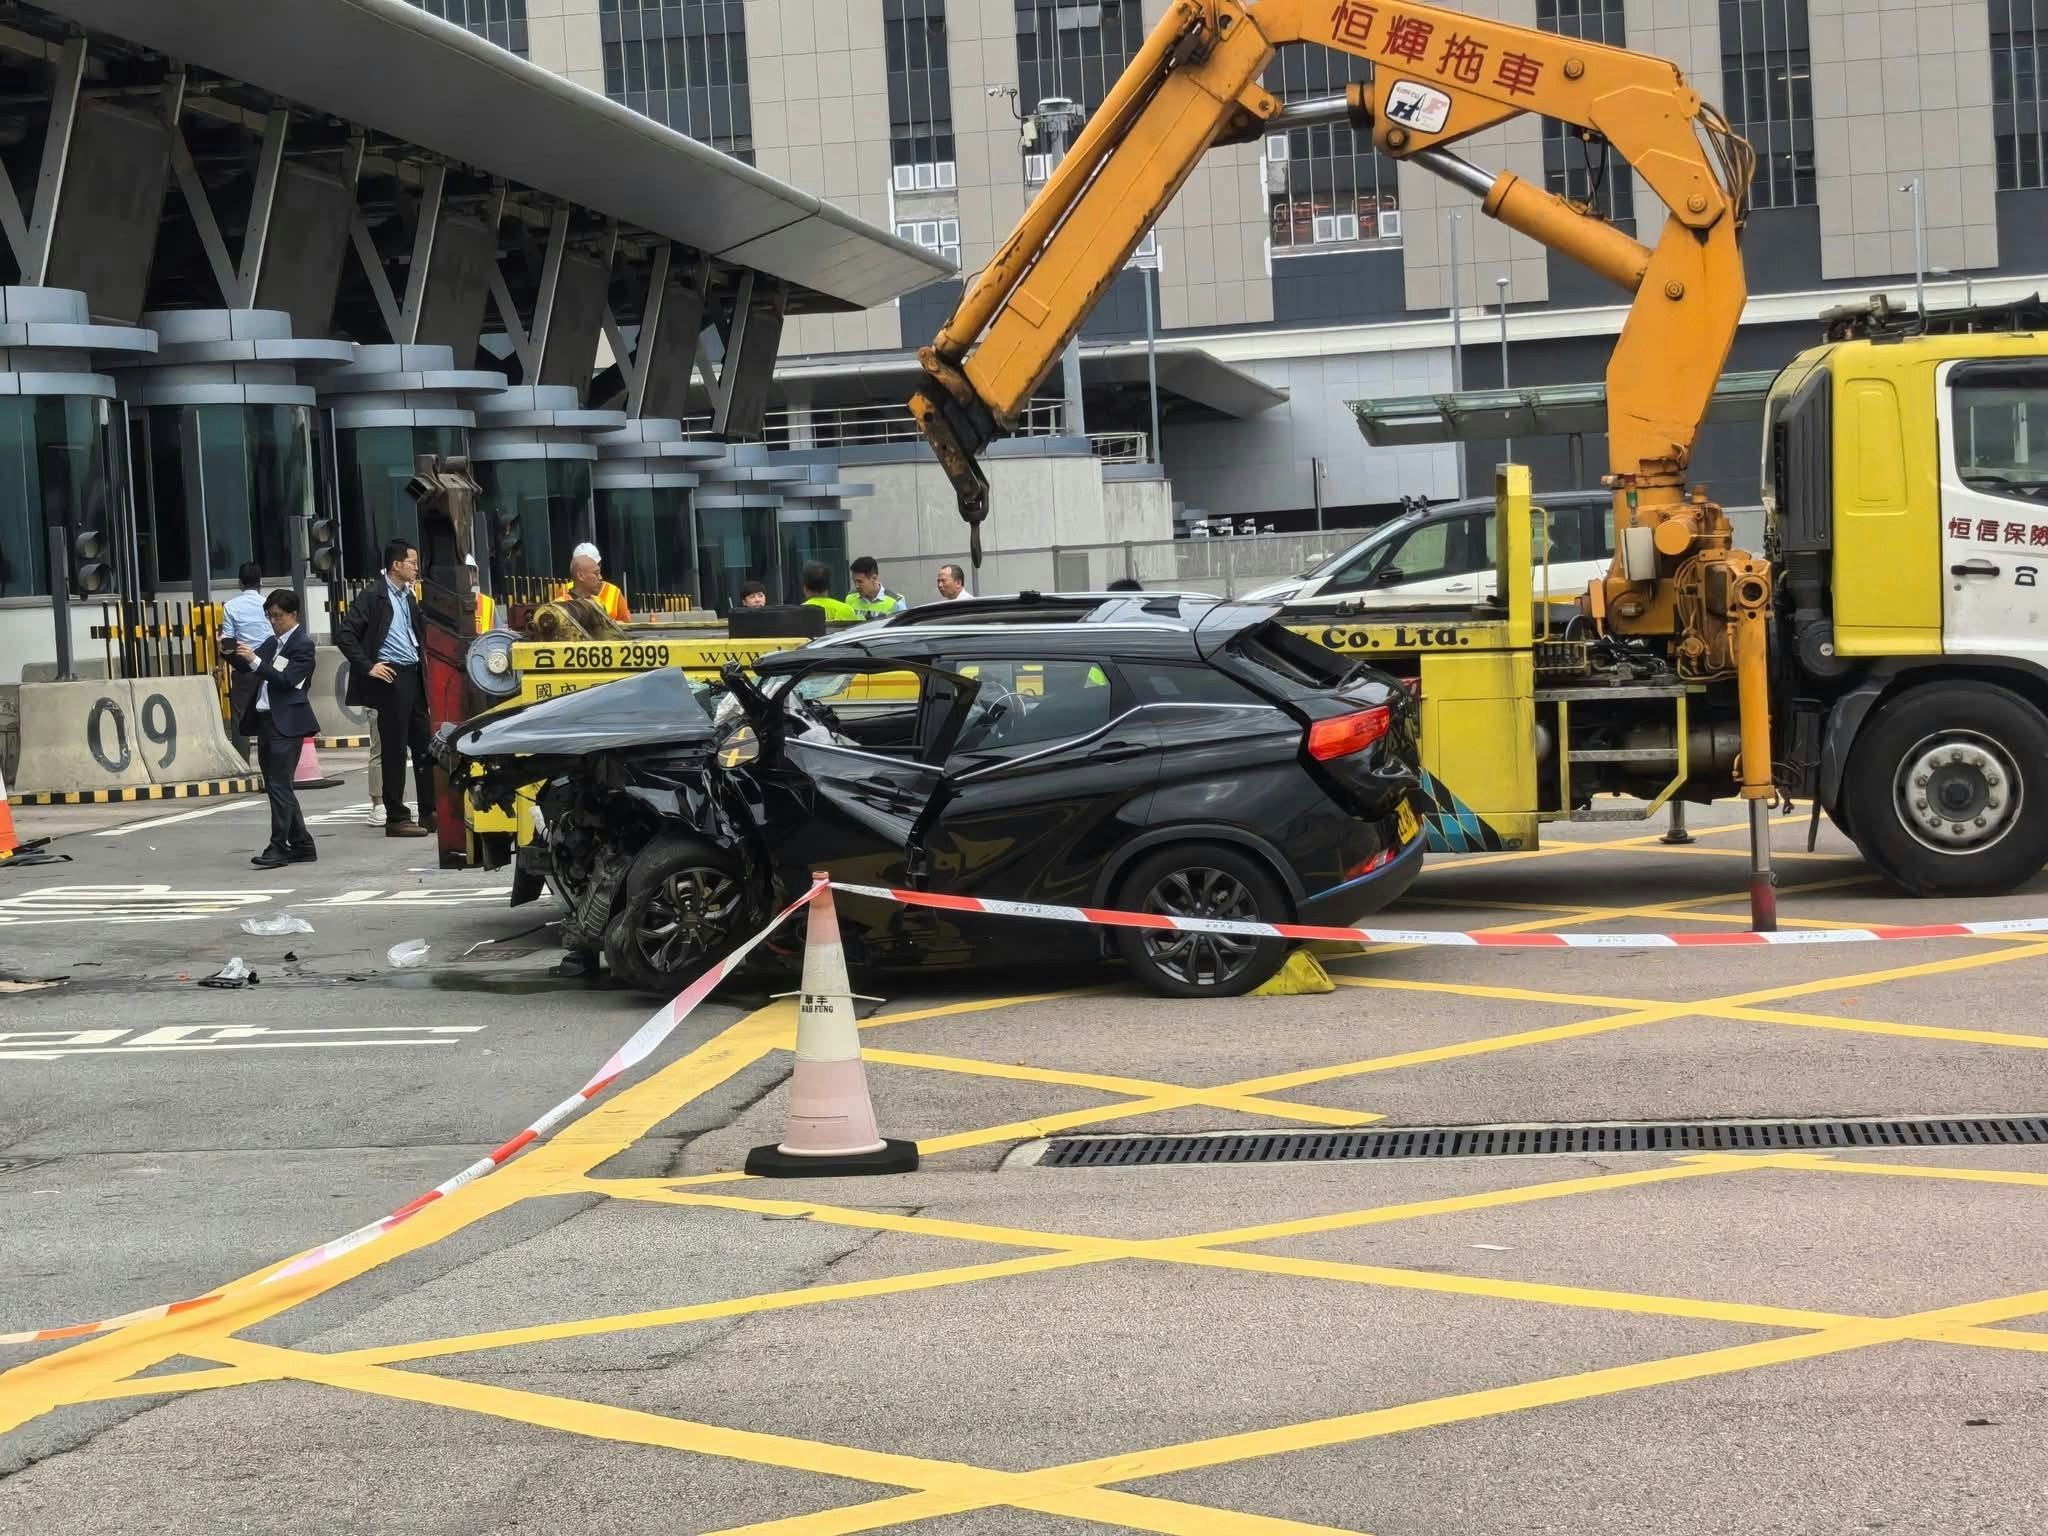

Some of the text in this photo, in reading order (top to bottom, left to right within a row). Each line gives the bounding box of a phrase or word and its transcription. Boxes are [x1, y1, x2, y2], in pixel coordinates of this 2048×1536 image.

[1331, 0, 1544, 96] 恒輝拖車
[1321, 625, 1469, 649] Co. Ltd.
[564, 647, 613, 668] 2668
[620, 645, 670, 667] 2999
[87, 693, 177, 773] 09
[814, 1005, 833, 1013] FUNG
